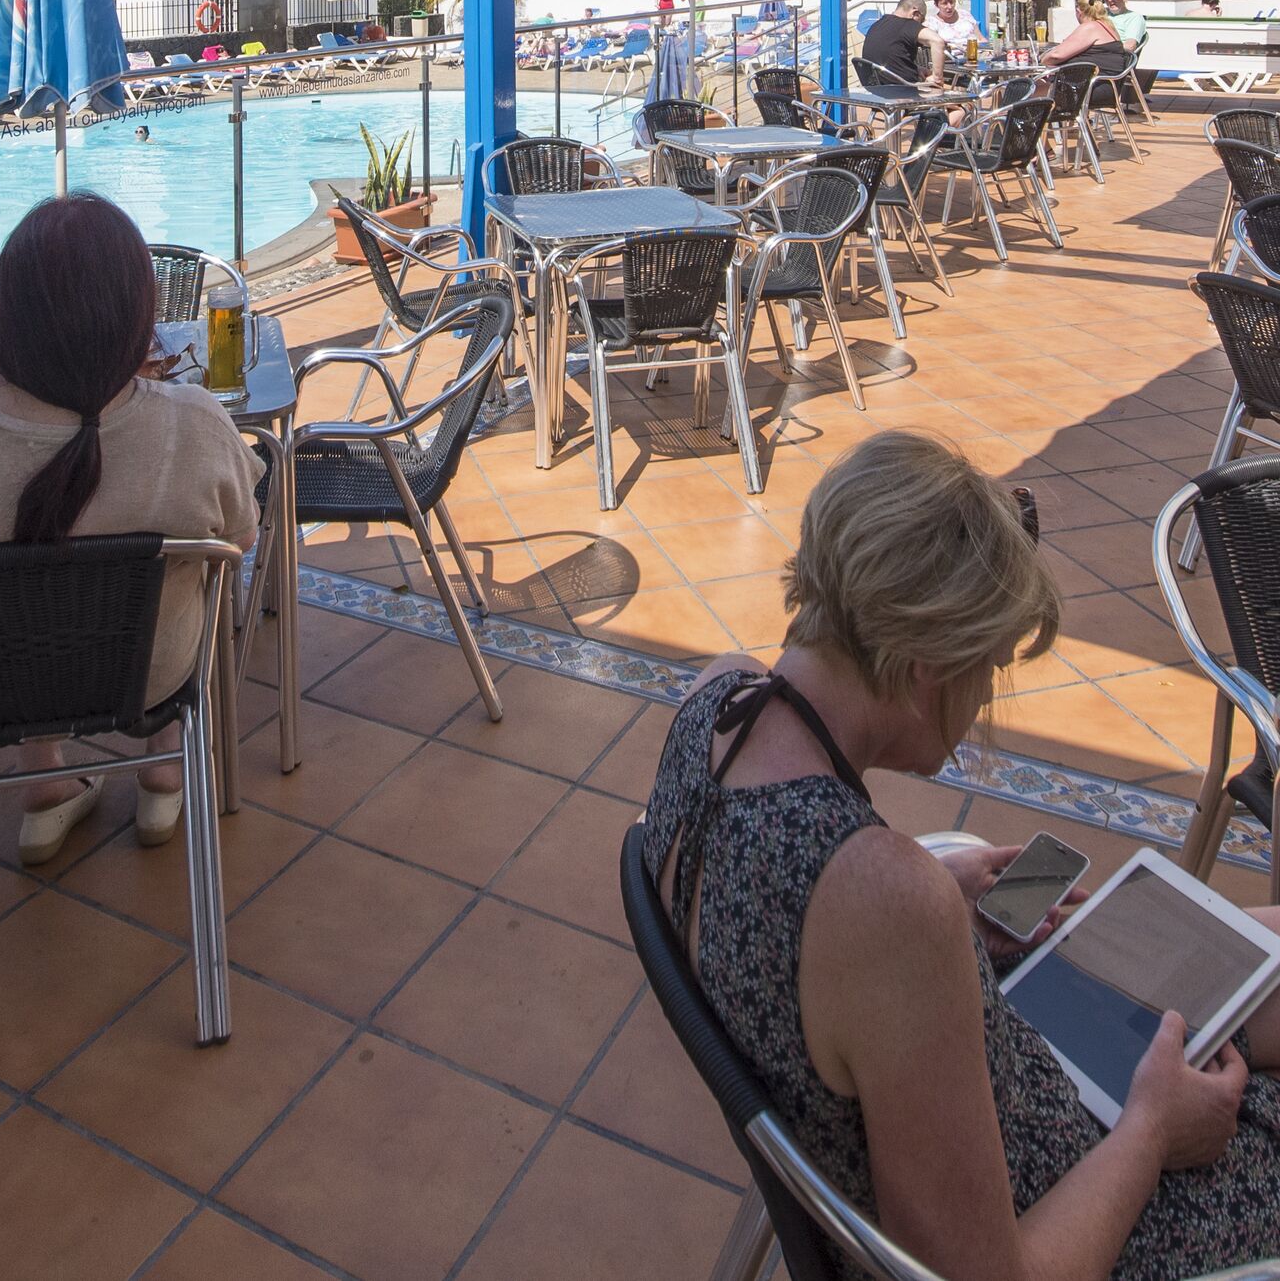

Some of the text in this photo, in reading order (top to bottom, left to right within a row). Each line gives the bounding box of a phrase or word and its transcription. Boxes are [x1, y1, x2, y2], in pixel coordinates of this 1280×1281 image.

[258, 67, 410, 99] www.jablebermudaslanzarote.com
[0, 121, 31, 139] Ask
[35, 116, 77, 133] abt
[155, 94, 207, 119] program
